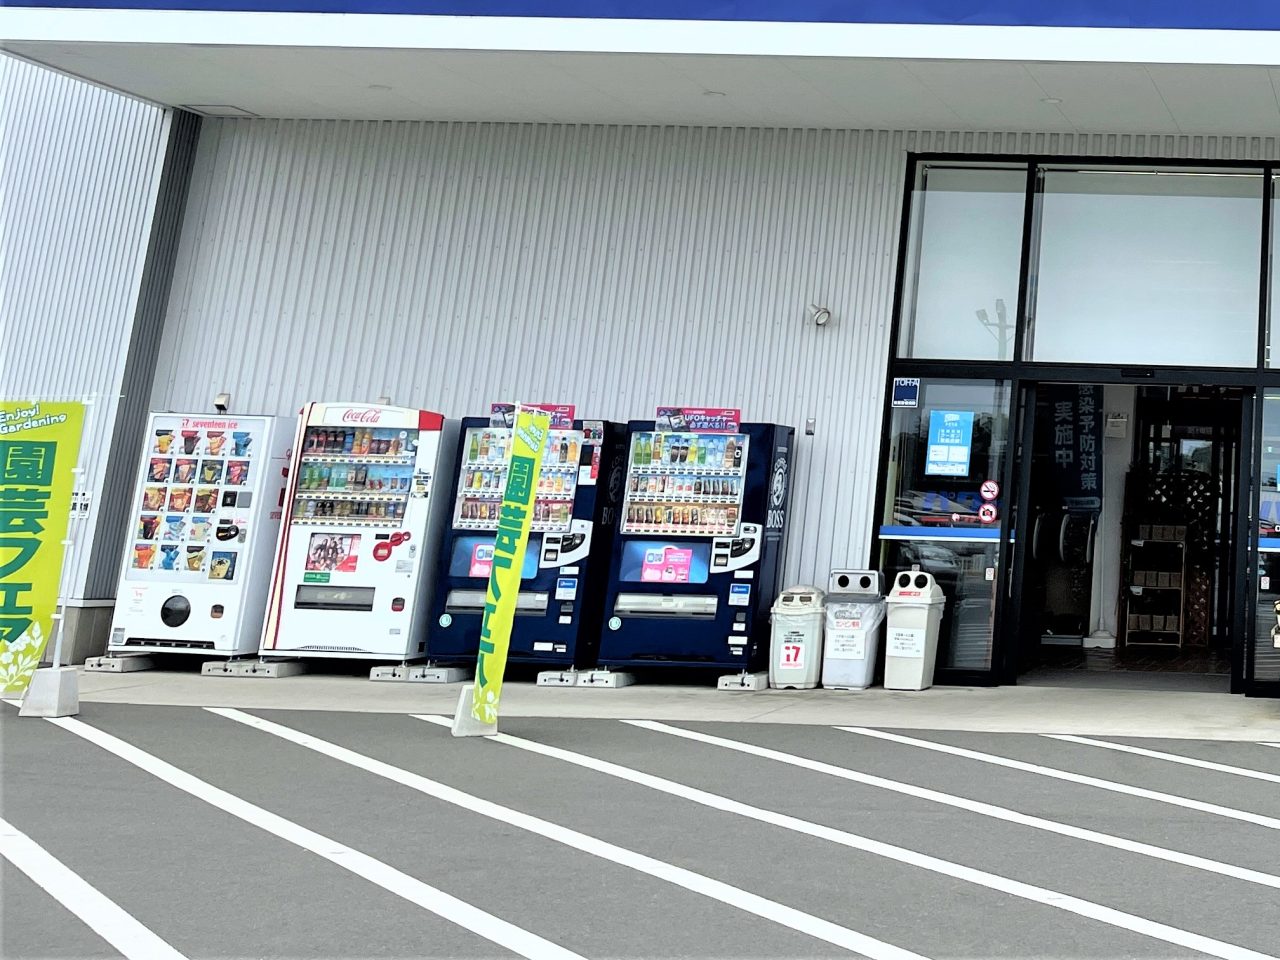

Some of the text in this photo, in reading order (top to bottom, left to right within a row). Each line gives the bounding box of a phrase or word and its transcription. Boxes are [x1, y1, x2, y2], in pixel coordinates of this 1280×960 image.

[0, 404, 40, 422] Enjoy!
[0, 413, 67, 434] Gardening
[1054, 401, 1074, 469] 実施中
[766, 509, 785, 529] BOSS
